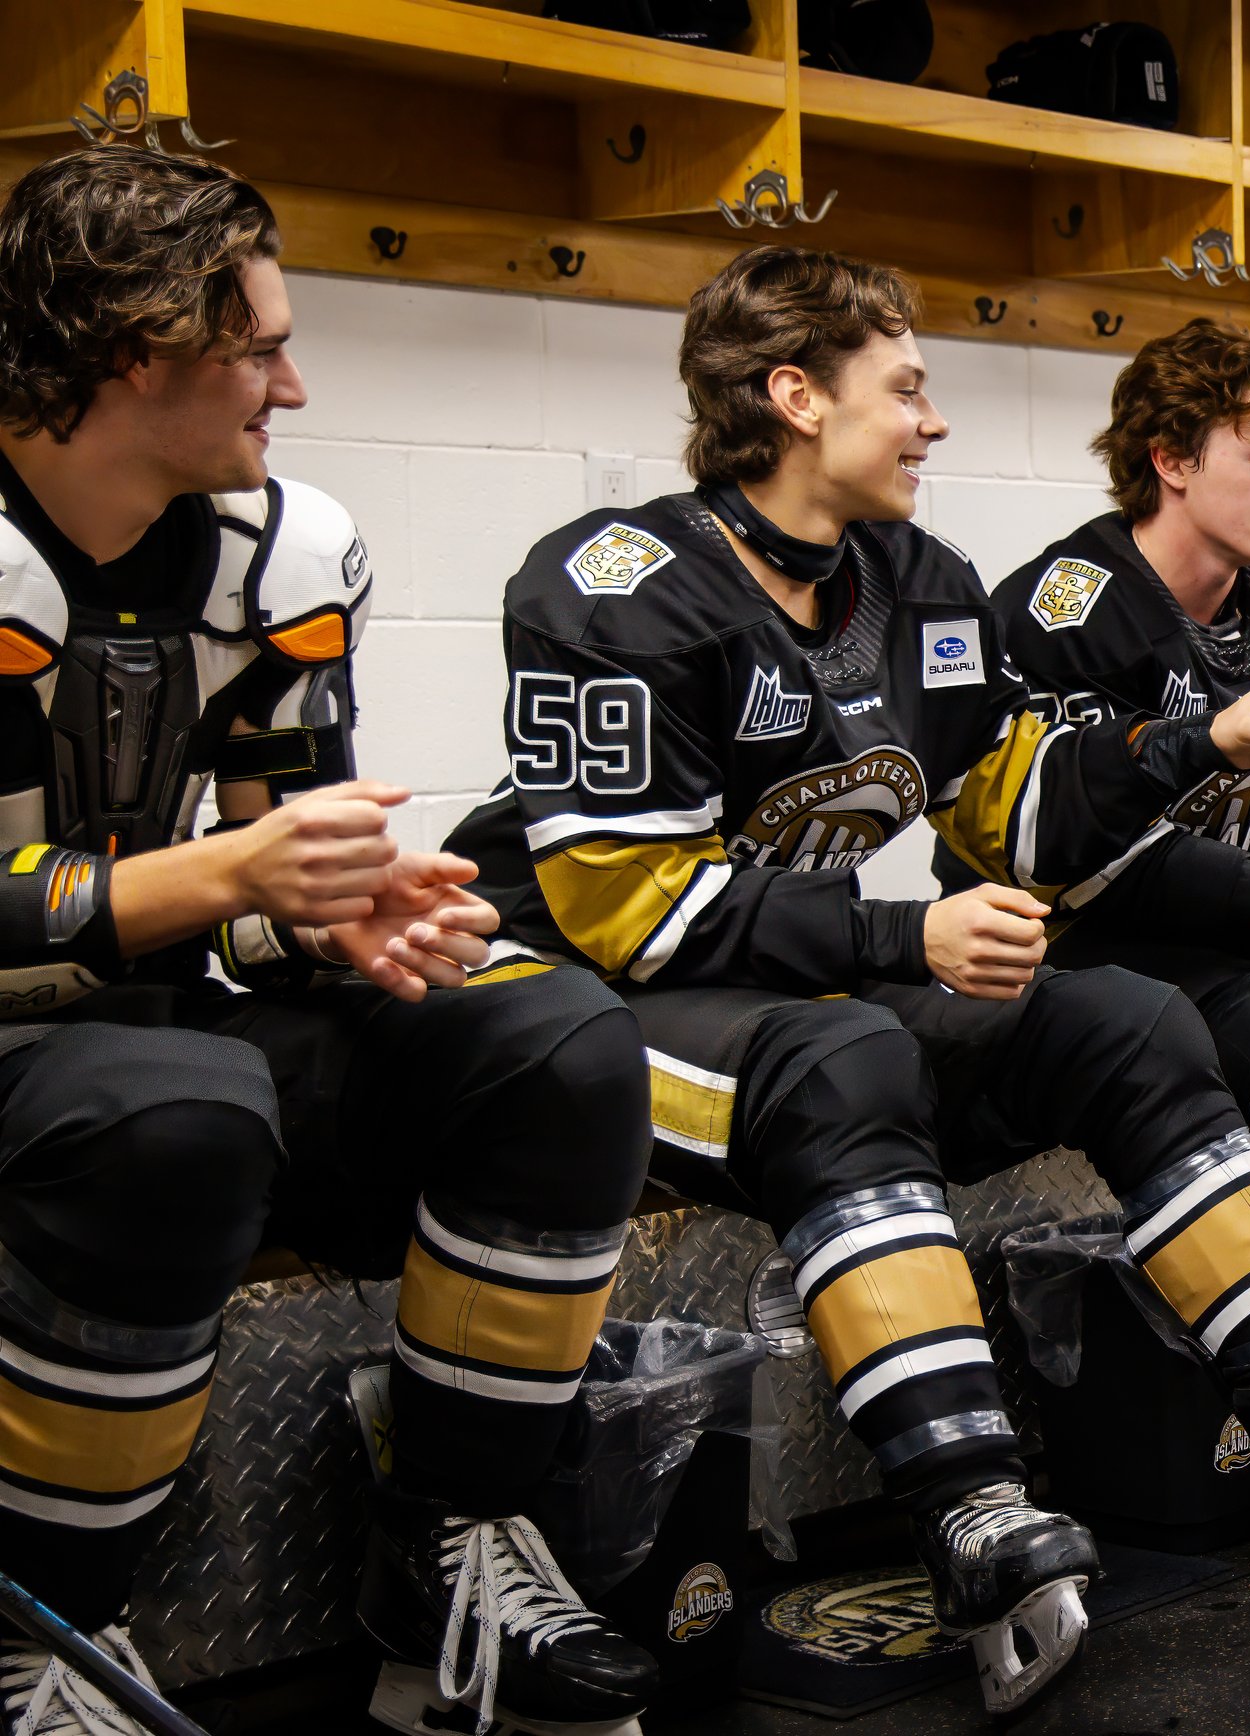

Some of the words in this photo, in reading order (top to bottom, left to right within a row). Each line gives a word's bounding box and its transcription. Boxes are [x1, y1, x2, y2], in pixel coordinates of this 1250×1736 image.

[928, 661, 976, 675] SUBARU
[838, 696, 883, 717] CCM
[511, 671, 652, 795] 59
[760, 757, 921, 826] CHARLOTTETOW
[669, 1591, 732, 1631] ISLANDERS
